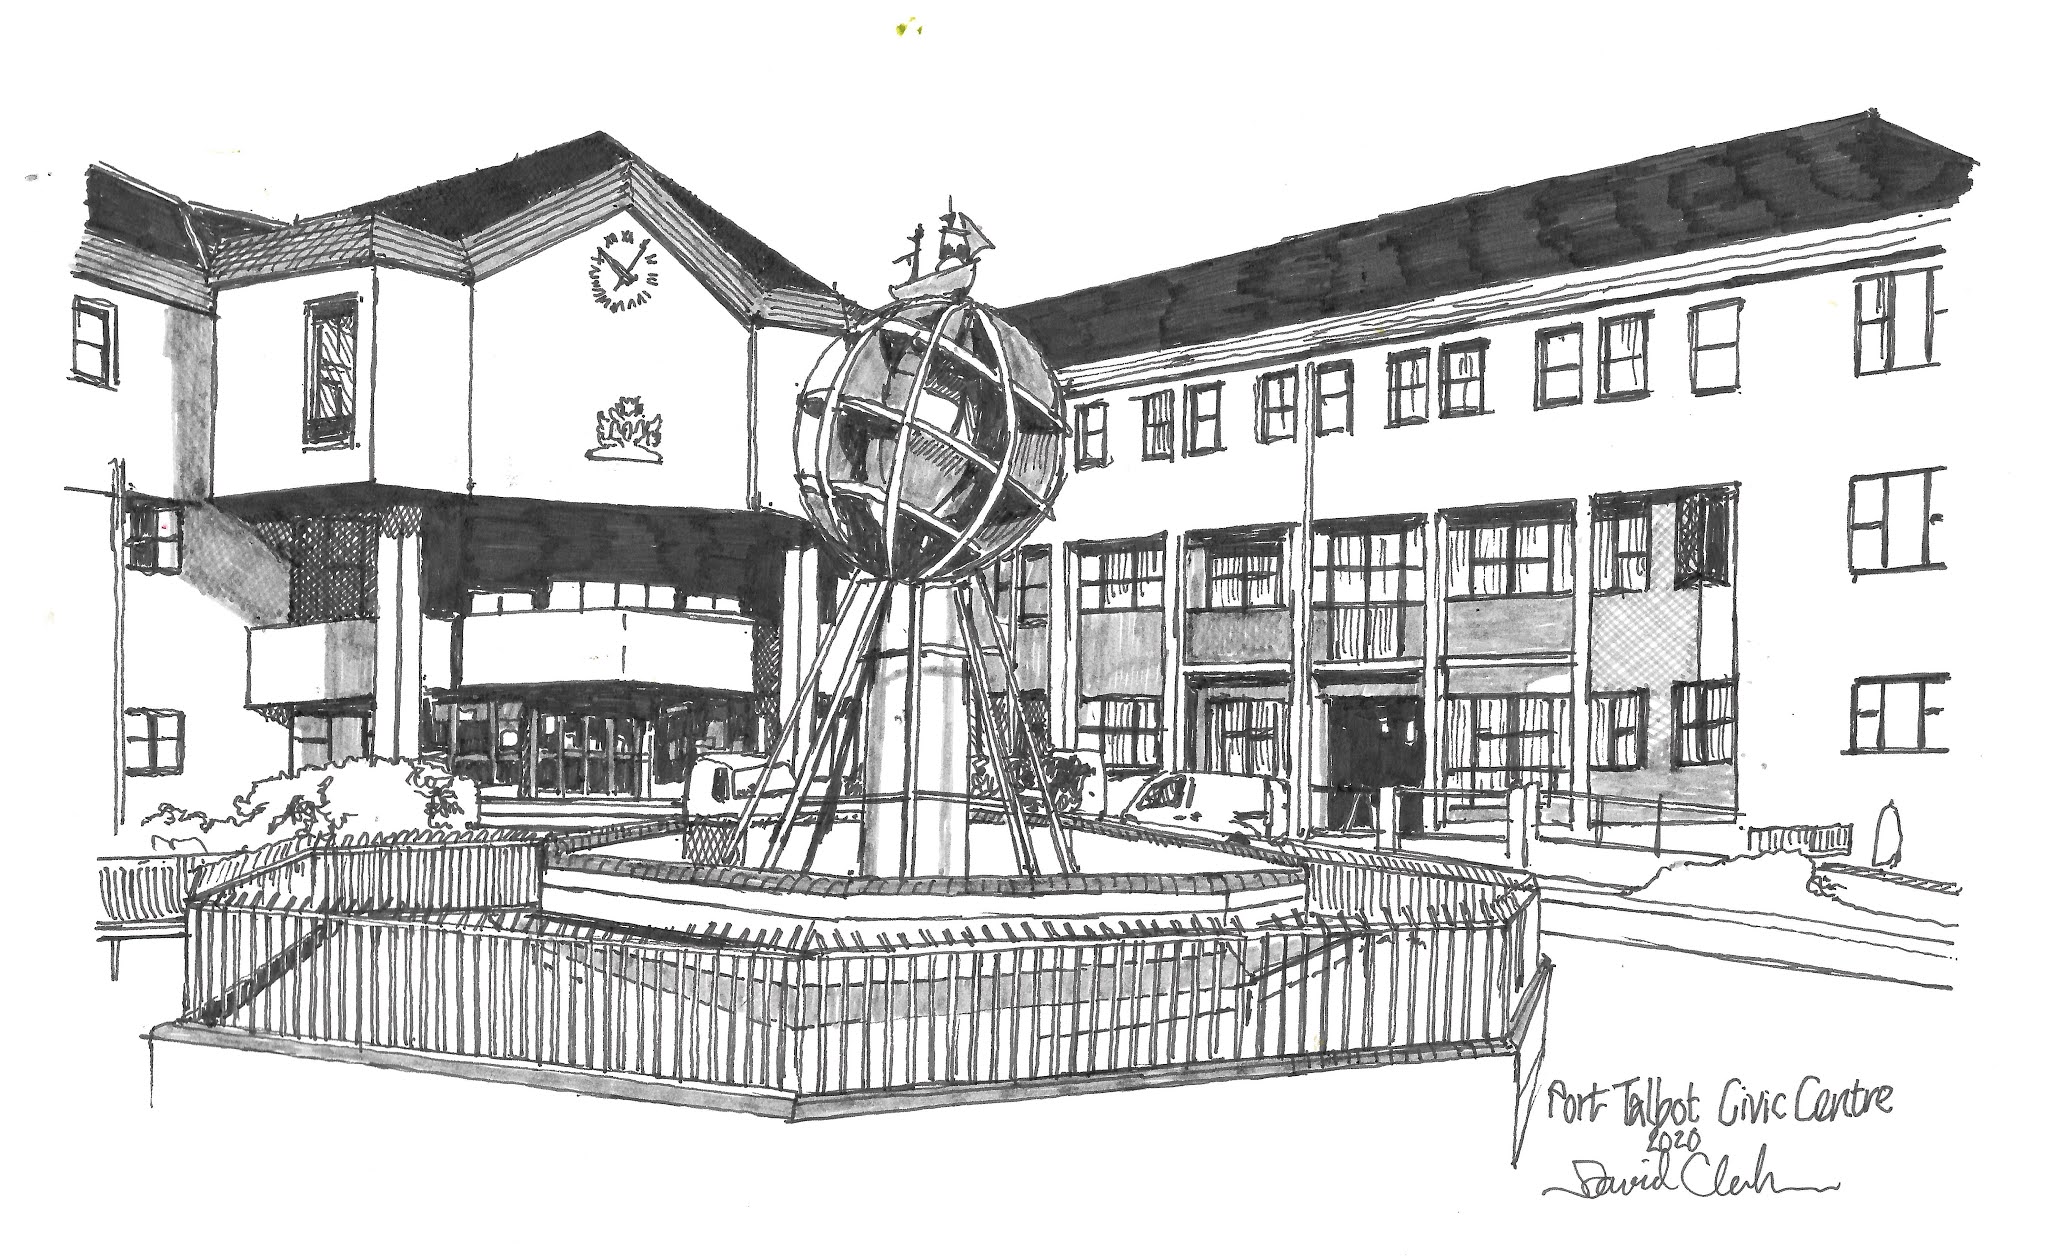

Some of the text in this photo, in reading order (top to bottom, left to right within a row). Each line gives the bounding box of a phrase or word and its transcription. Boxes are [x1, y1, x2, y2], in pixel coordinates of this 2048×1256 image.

[1547, 1074, 1894, 1128] Port Talbot Civic Centre
[1646, 1126, 1702, 1152] 2020
[1542, 1148, 1680, 1199] David
